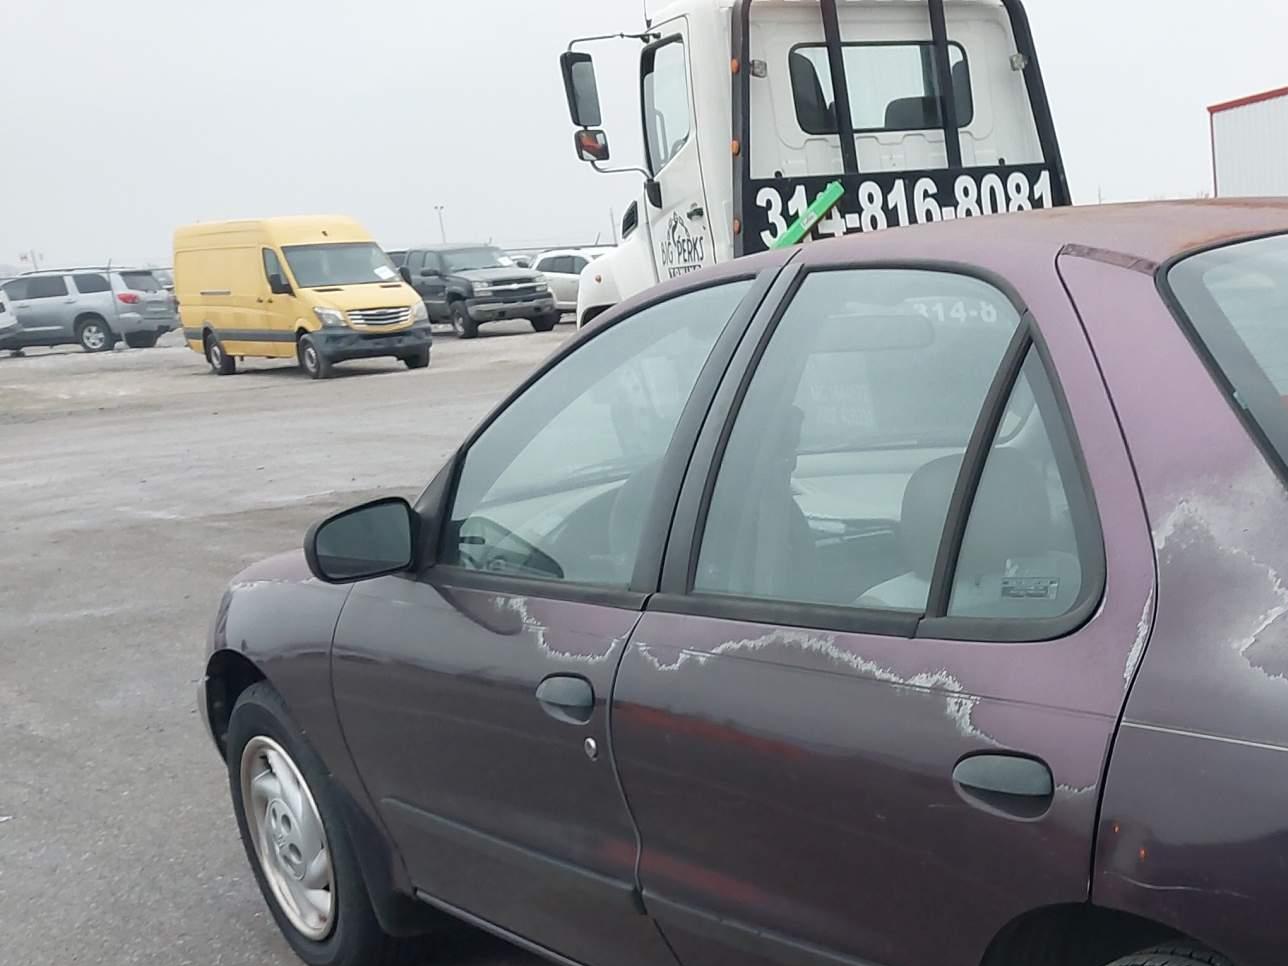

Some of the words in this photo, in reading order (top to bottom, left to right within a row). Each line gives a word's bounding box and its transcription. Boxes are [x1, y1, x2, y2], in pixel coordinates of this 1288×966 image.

[756, 169, 1053, 249] 314-816-8081
[661, 241, 674, 265] BIG
[676, 236, 704, 263] PERKS
